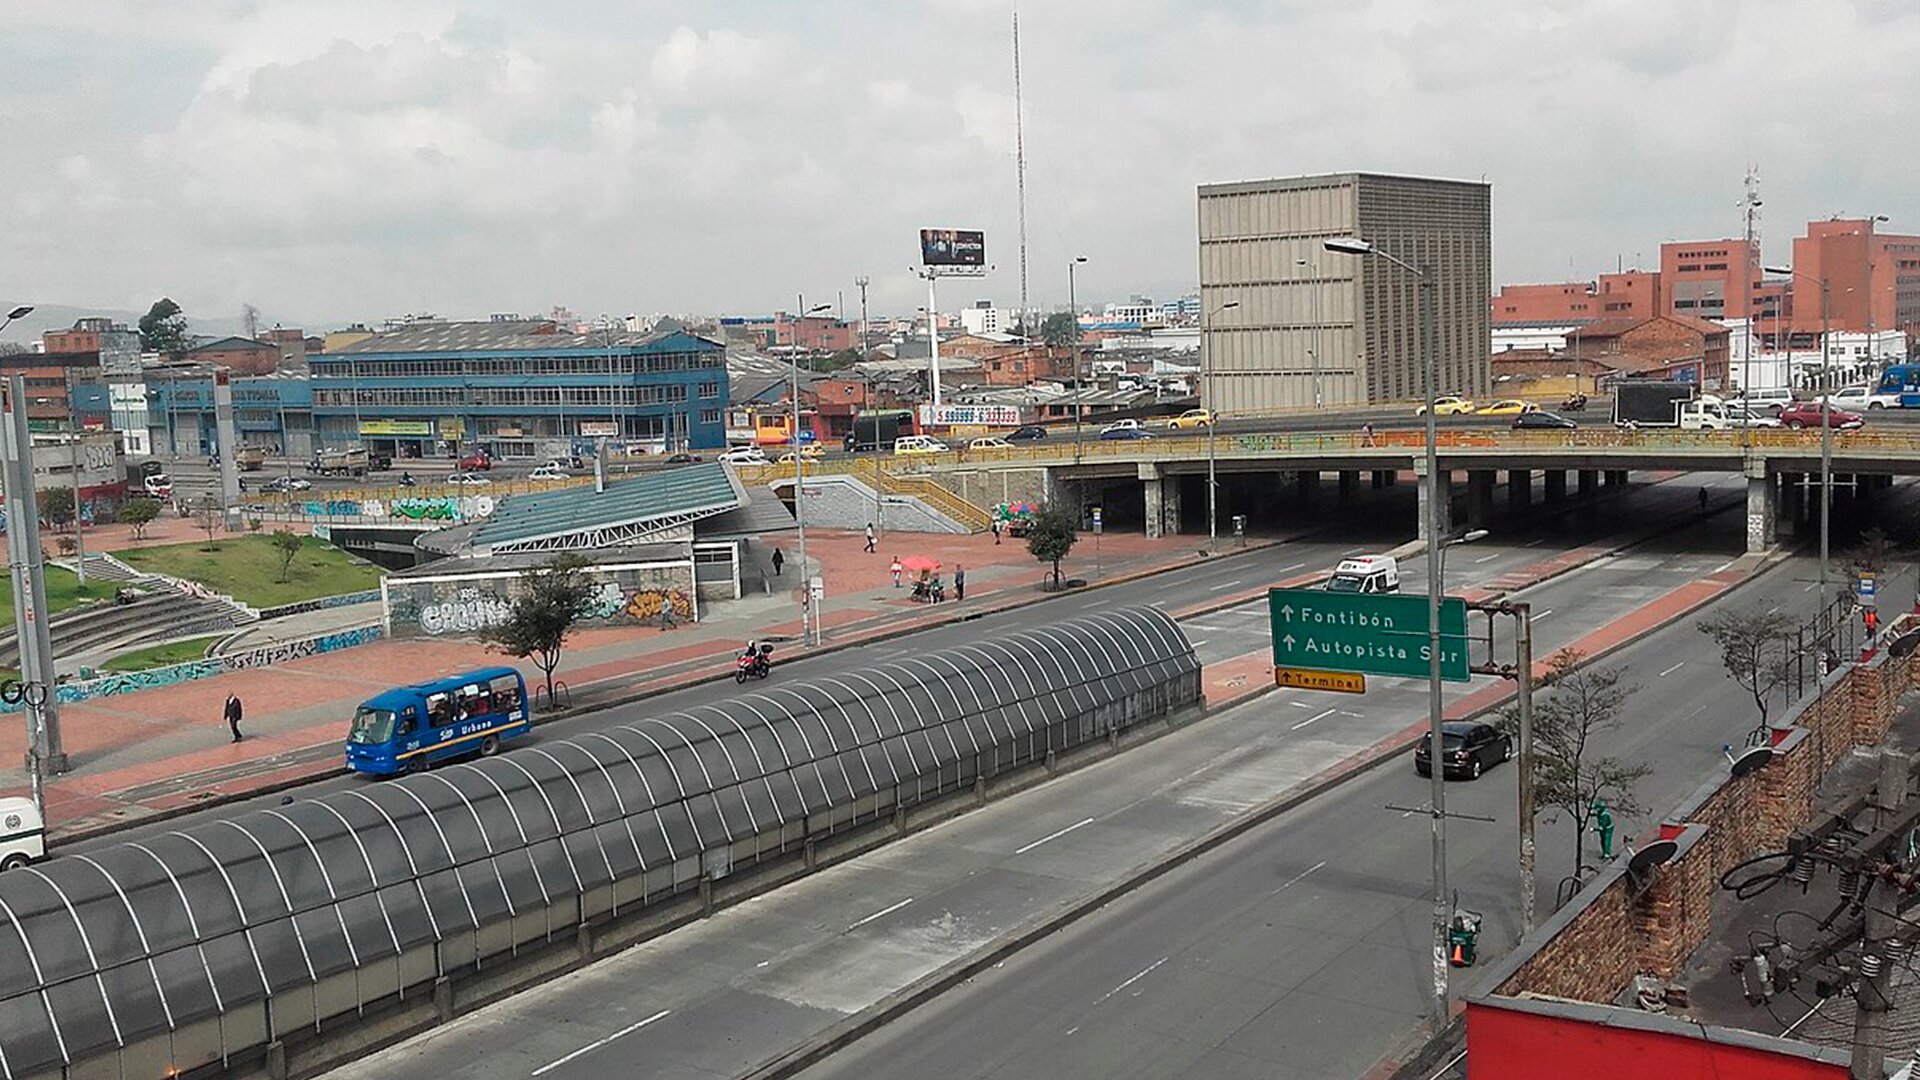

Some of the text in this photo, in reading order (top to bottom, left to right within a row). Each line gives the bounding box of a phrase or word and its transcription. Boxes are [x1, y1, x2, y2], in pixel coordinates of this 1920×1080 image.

[1301, 608, 1394, 628] Fontibón
[1305, 638, 1407, 660] Autopista
[1296, 674, 1360, 689] Terminal
[461, 720, 492, 735] Urbano
